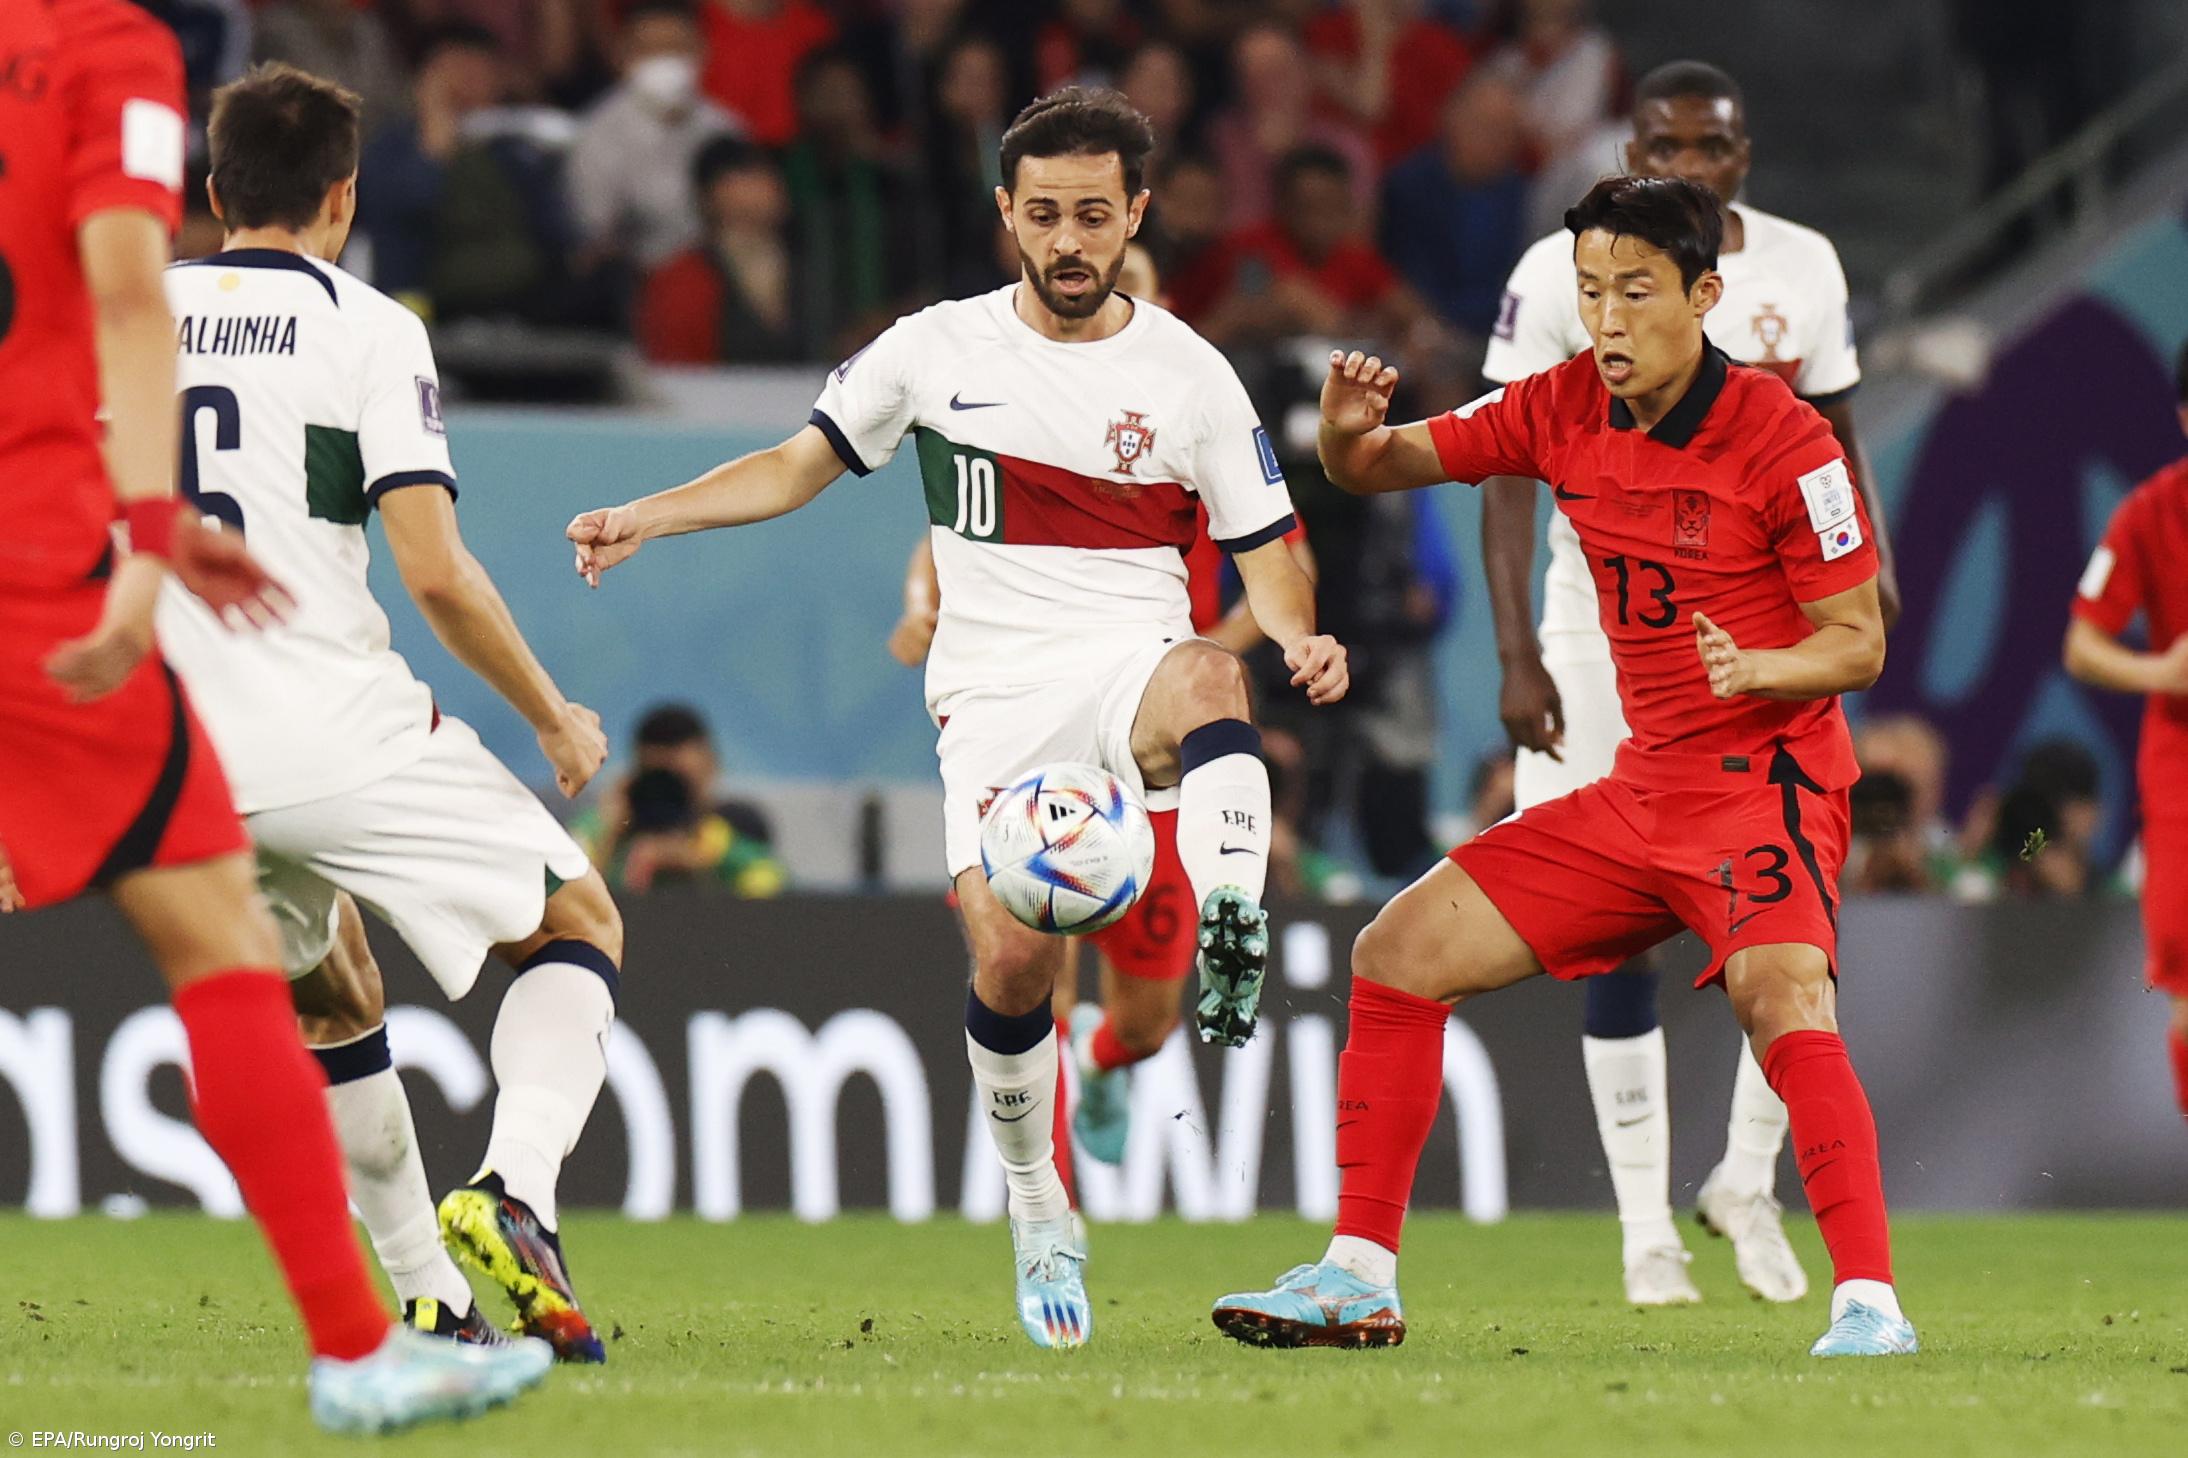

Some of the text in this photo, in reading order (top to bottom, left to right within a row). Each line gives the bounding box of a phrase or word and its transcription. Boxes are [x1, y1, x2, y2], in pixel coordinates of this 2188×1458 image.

[173, 315, 297, 356] ALHINHA
[953, 453, 996, 538] 10
[1674, 548, 1709, 561] KOREA
[1603, 554, 1678, 629] 13
[1706, 844, 1793, 916] 13
[1143, 884, 1180, 946] 6
